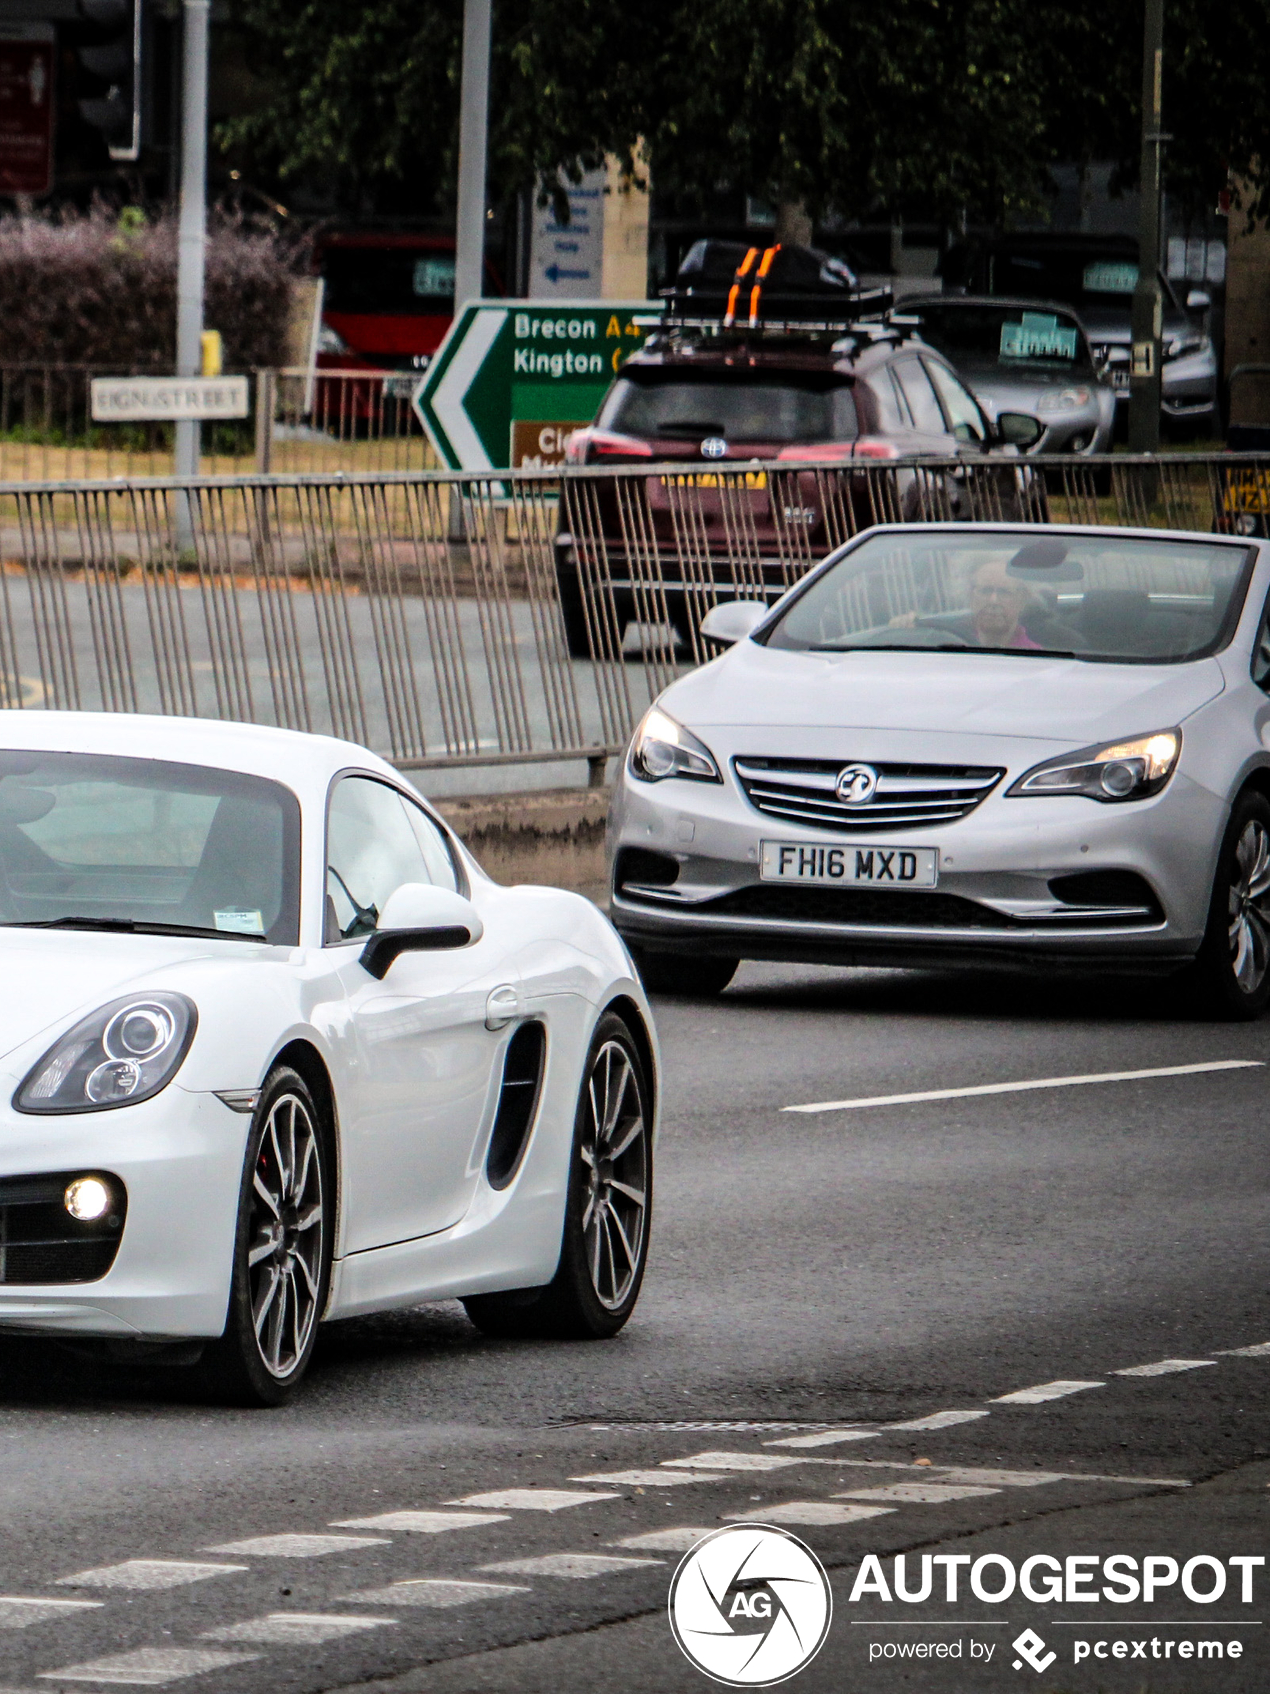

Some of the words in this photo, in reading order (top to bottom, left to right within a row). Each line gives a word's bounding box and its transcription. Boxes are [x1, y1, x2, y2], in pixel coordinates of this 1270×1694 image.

[514, 313, 596, 339] Brecon
[514, 347, 603, 378] Kington
[154, 387, 240, 409] STREET
[779, 847, 845, 878] FH16
[854, 850, 917, 881] MXD
